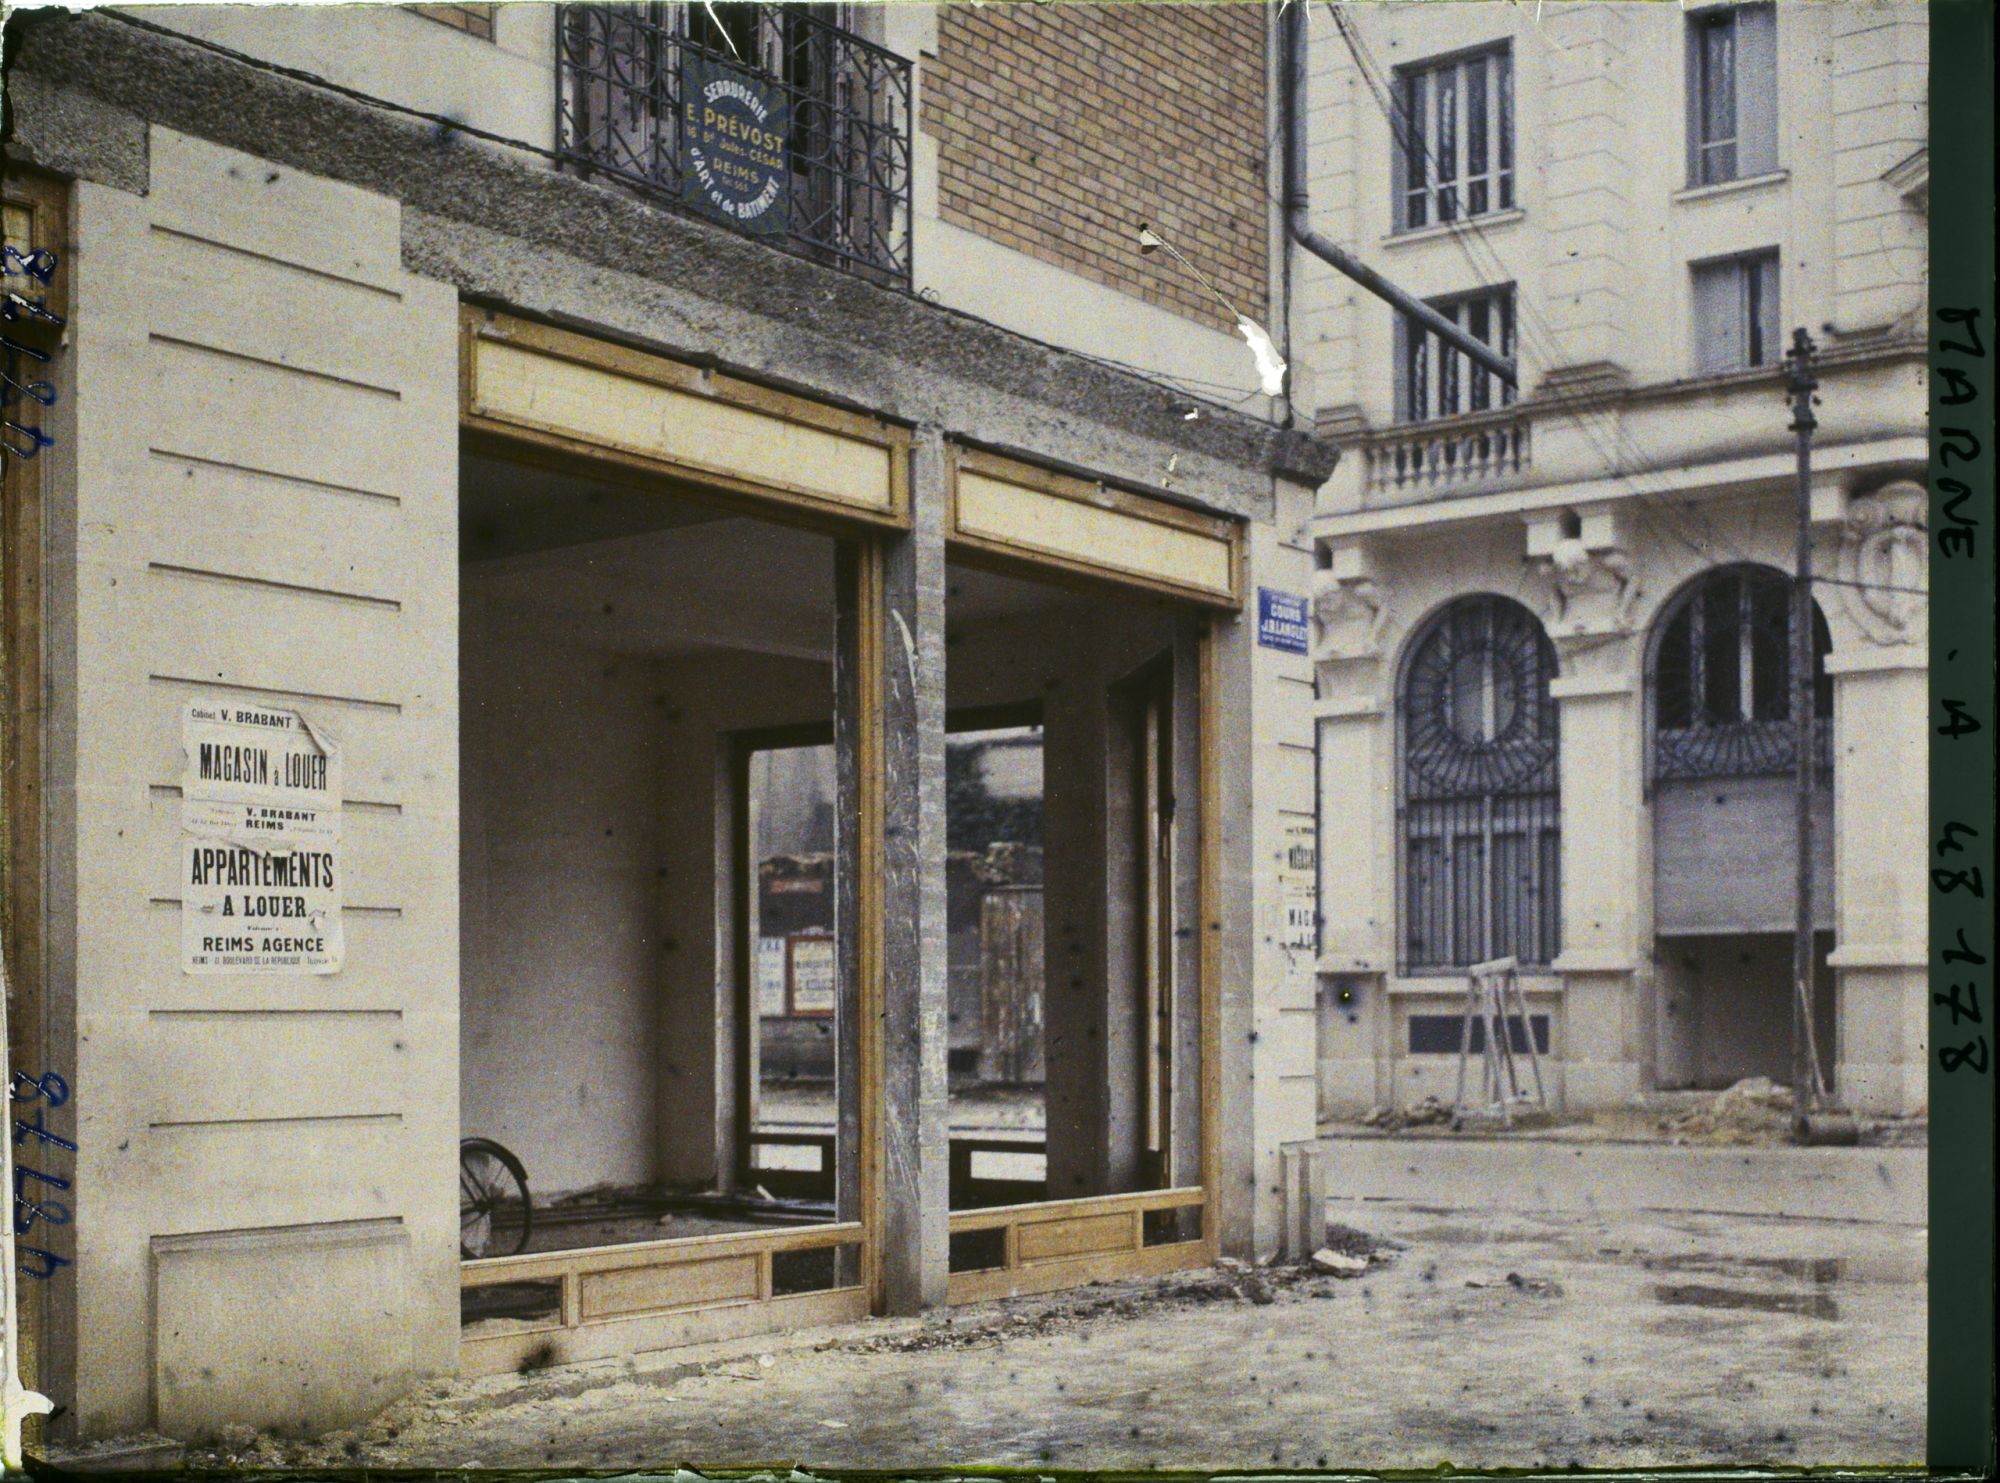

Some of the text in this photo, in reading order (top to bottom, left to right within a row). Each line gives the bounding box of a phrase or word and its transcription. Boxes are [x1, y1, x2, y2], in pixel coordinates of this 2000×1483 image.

[704, 107, 784, 154] PRÉVOST
[712, 157, 760, 185] REIMS
[1936, 306, 1986, 559] MARNE
[220, 709, 232, 722] V.
[236, 711, 292, 729] BRABANT
[1937, 698, 1982, 740] A
[200, 742, 267, 786] MAGASIN
[285, 752, 327, 791] LOUER
[245, 819, 285, 831] REIMS
[246, 807, 257, 818] V.
[260, 808, 316, 822] BRABANT
[191, 847, 334, 889] APPARTEMENTS
[222, 894, 307, 918] A LOUER
[203, 937, 325, 952] REIMS AGENCE
